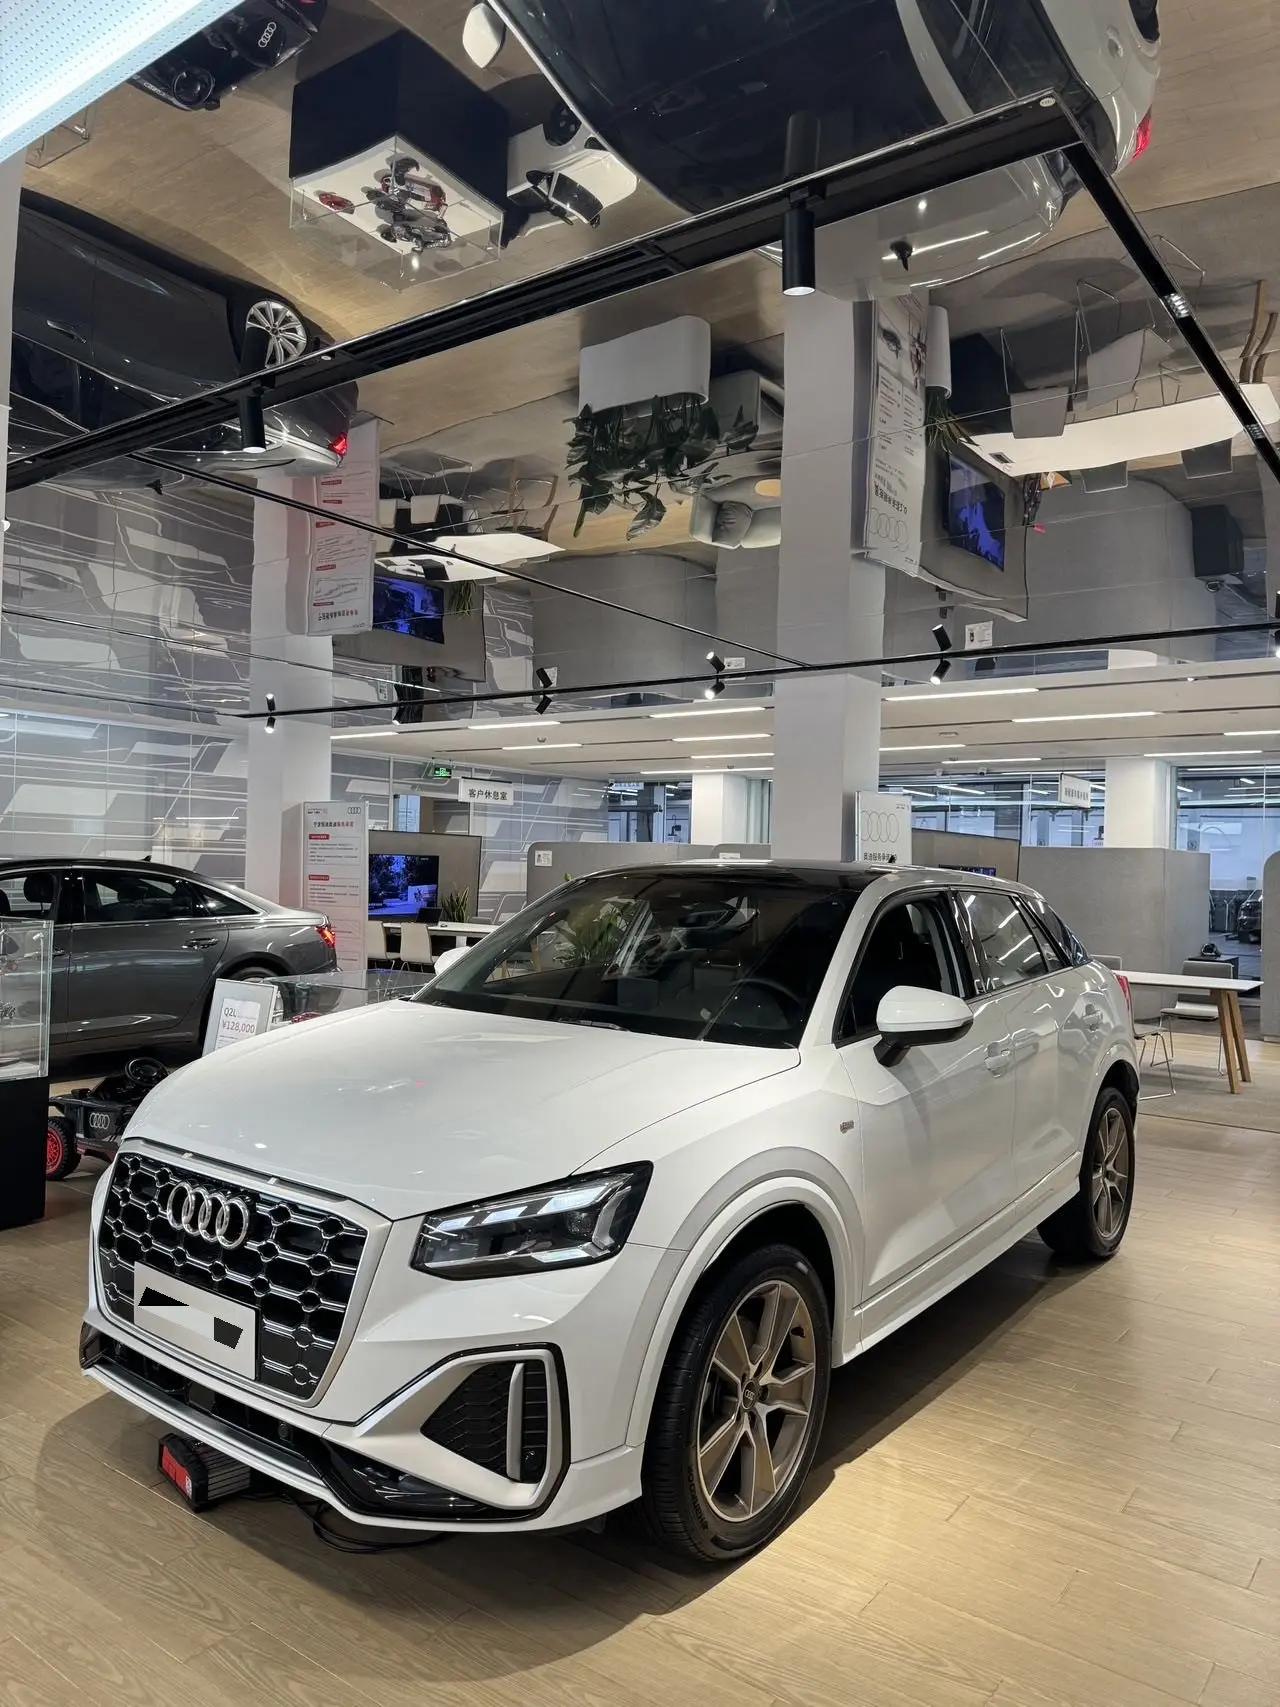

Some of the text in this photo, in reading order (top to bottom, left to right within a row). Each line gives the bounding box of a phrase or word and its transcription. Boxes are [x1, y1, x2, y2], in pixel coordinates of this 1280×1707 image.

[469, 789, 508, 801] 客户休息室
[224, 1007, 238, 1018] Q2L
[222, 1020, 256, 1034] ¥128,000
